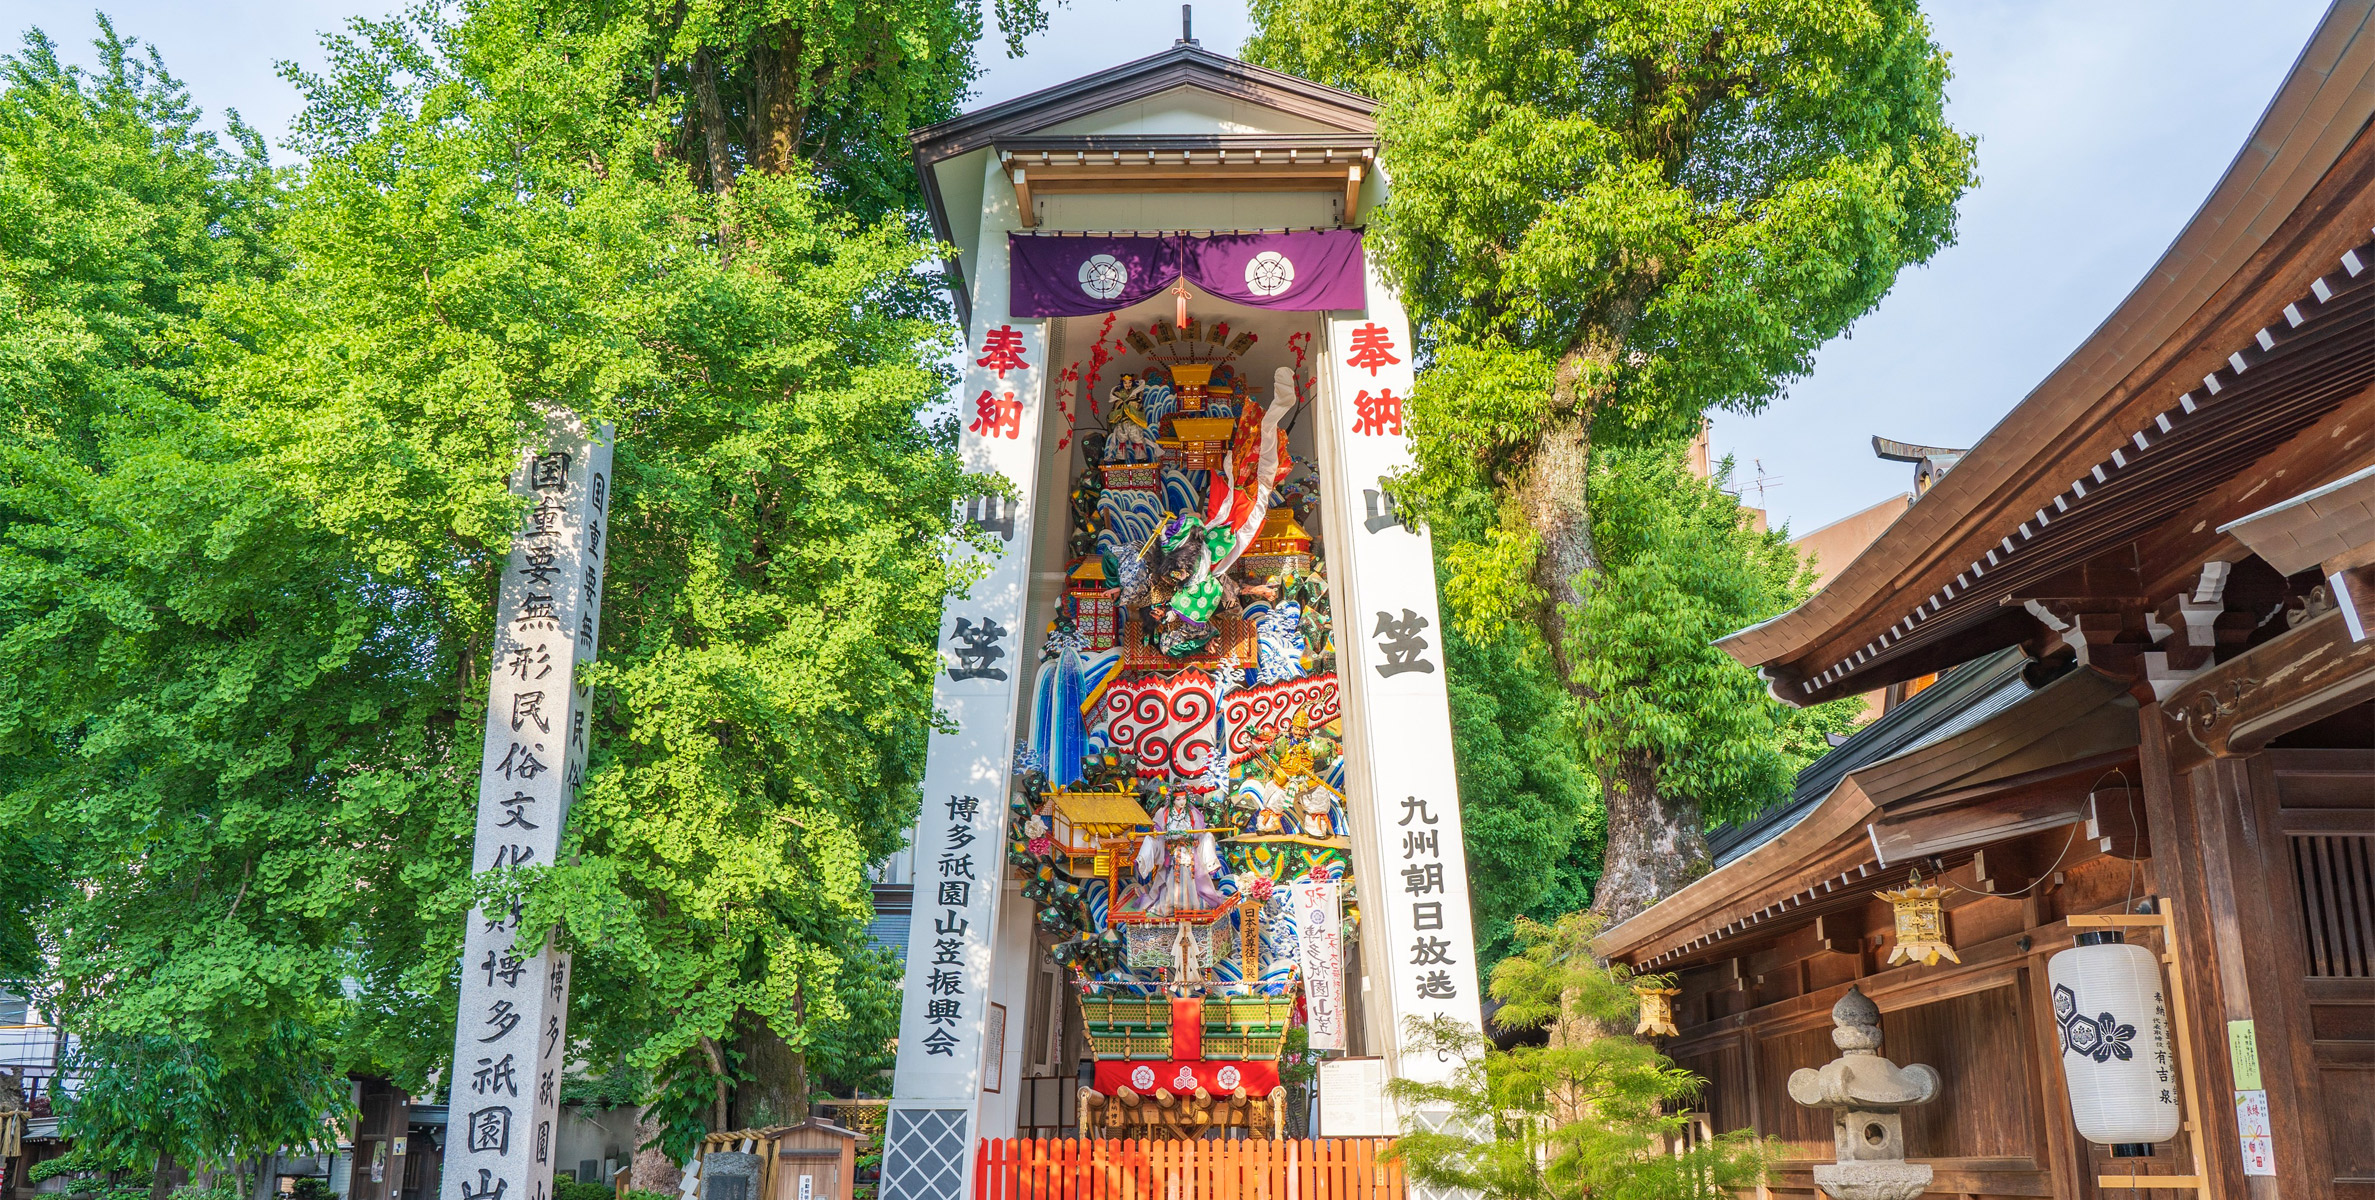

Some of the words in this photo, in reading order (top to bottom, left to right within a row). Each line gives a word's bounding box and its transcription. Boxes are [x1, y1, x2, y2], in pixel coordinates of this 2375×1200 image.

[969, 325, 1030, 439] 奉納
[1346, 322, 1402, 437] 奉納
[1363, 475, 1435, 679] 山笠
[921, 795, 980, 1058] 博多祇園山笠振興会
[1397, 796, 1457, 1000] 九州朝日放送
